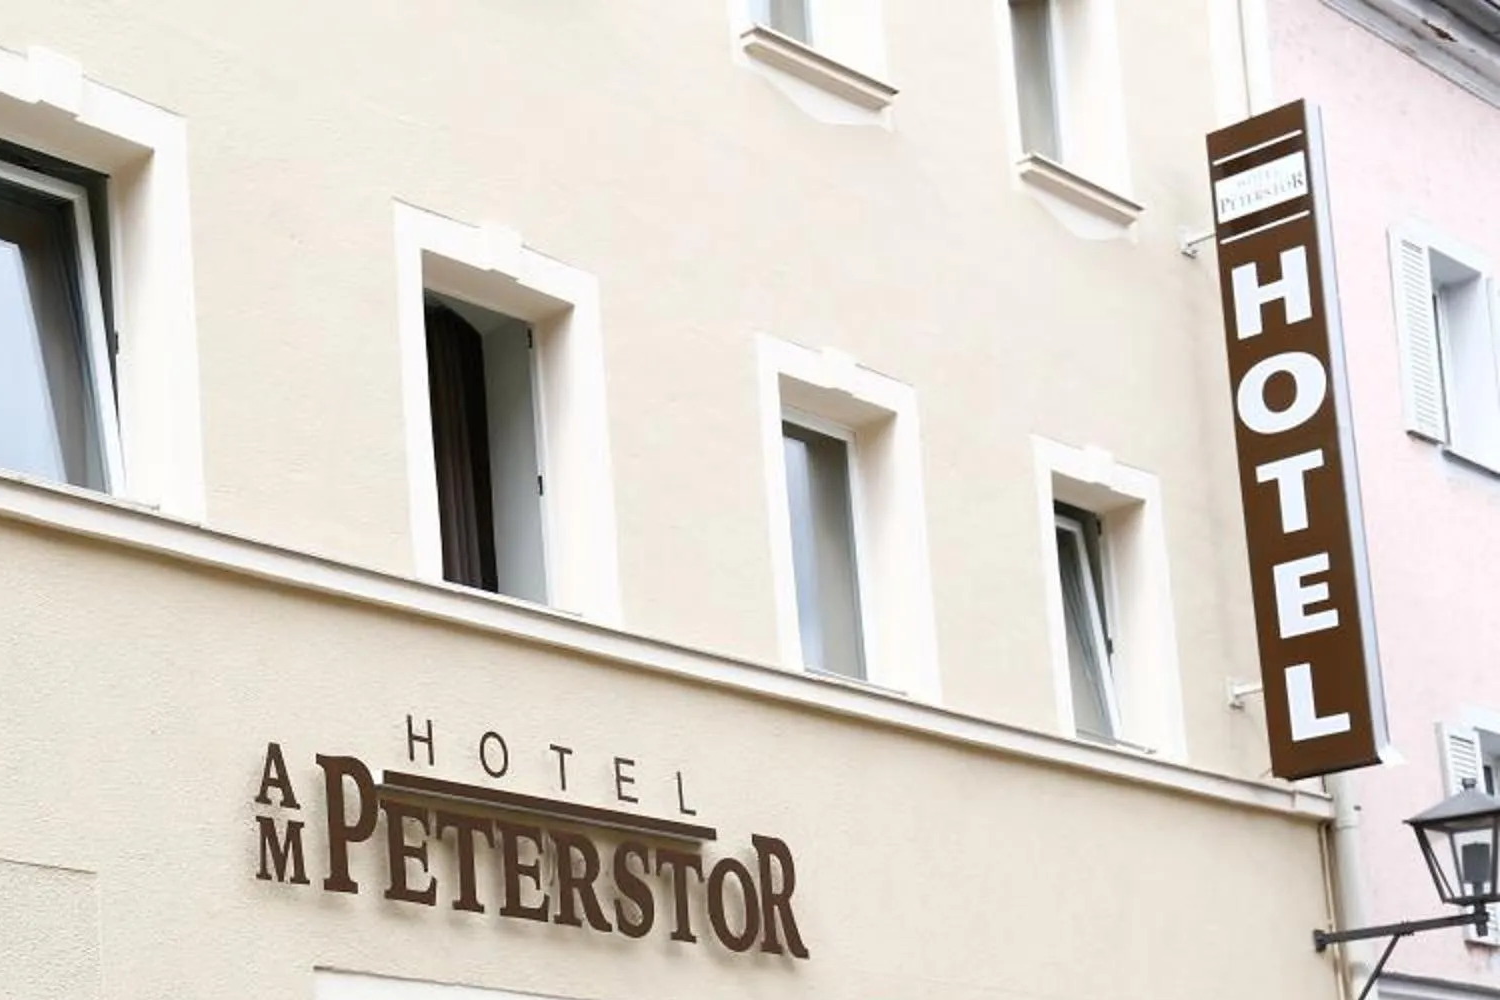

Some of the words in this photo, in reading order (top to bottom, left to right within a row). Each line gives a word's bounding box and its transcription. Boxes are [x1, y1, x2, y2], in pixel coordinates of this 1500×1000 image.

[1231, 245, 1350, 741] HOTEL
[316, 753, 808, 959] PETERSTOR
[406, 714, 696, 815] HOTEL
